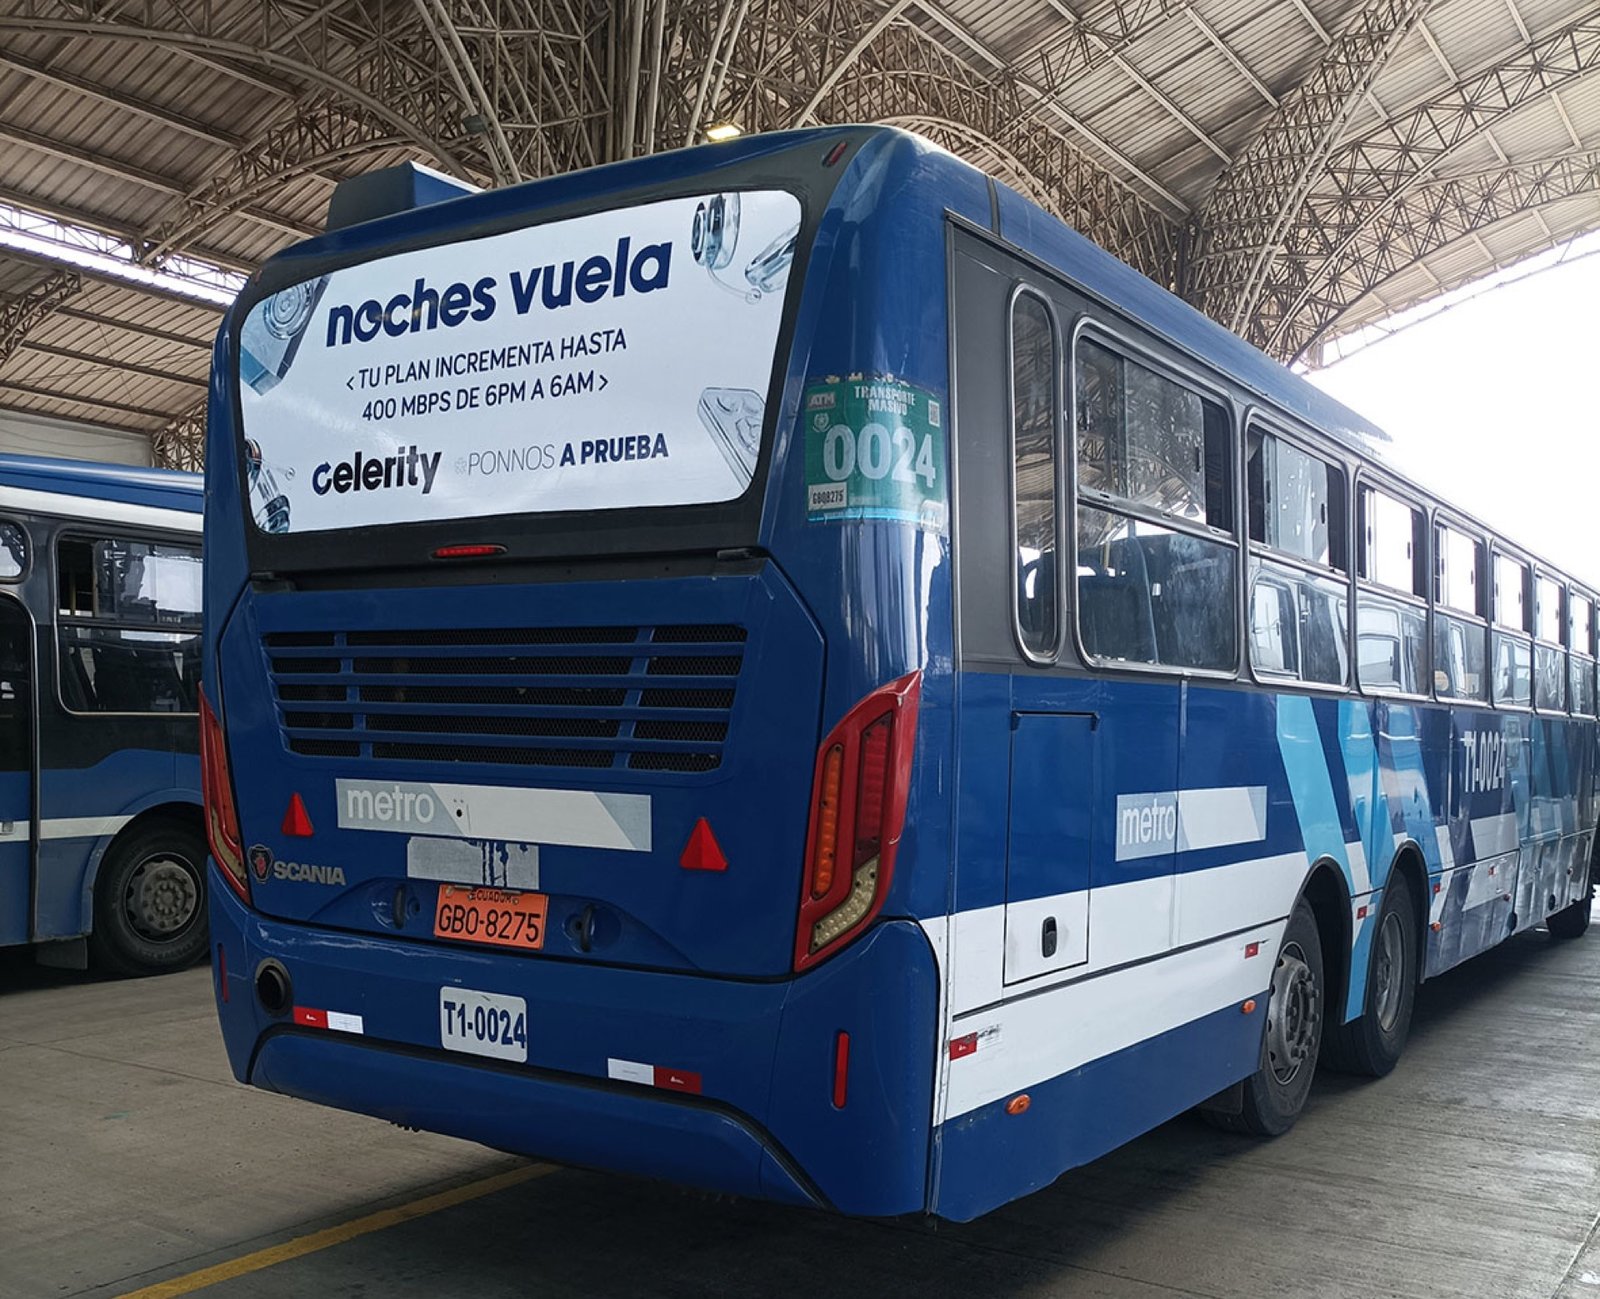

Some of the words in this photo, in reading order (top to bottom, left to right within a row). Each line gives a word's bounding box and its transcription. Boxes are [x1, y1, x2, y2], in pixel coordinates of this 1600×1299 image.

[326, 276, 497, 348] noches
[509, 236, 673, 315] vuela
[384, 359, 431, 386] PLAN
[435, 340, 555, 378] INCREMENTA
[560, 328, 627, 360] HASTA
[362, 397, 397, 421] 400
[401, 391, 451, 417] MBPS
[456, 387, 481, 410] DE
[485, 380, 526, 407] 6PM
[531, 378, 545, 401] A
[809, 391, 835, 407] ATM
[854, 386, 916, 406] TRANSPORTE
[868, 399, 908, 416] MASIVO
[312, 445, 443, 495] celerity
[468, 443, 555, 476] PONNOS
[560, 442, 576, 468] A
[580, 432, 669, 465] PRUEBA
[823, 422, 936, 488] 0024
[1463, 730, 1506, 793] T1-0024
[347, 785, 435, 824] metro
[1121, 797, 1177, 845] metro
[273, 860, 347, 887] SCANIA
[443, 1000, 527, 1050] T1-0024
